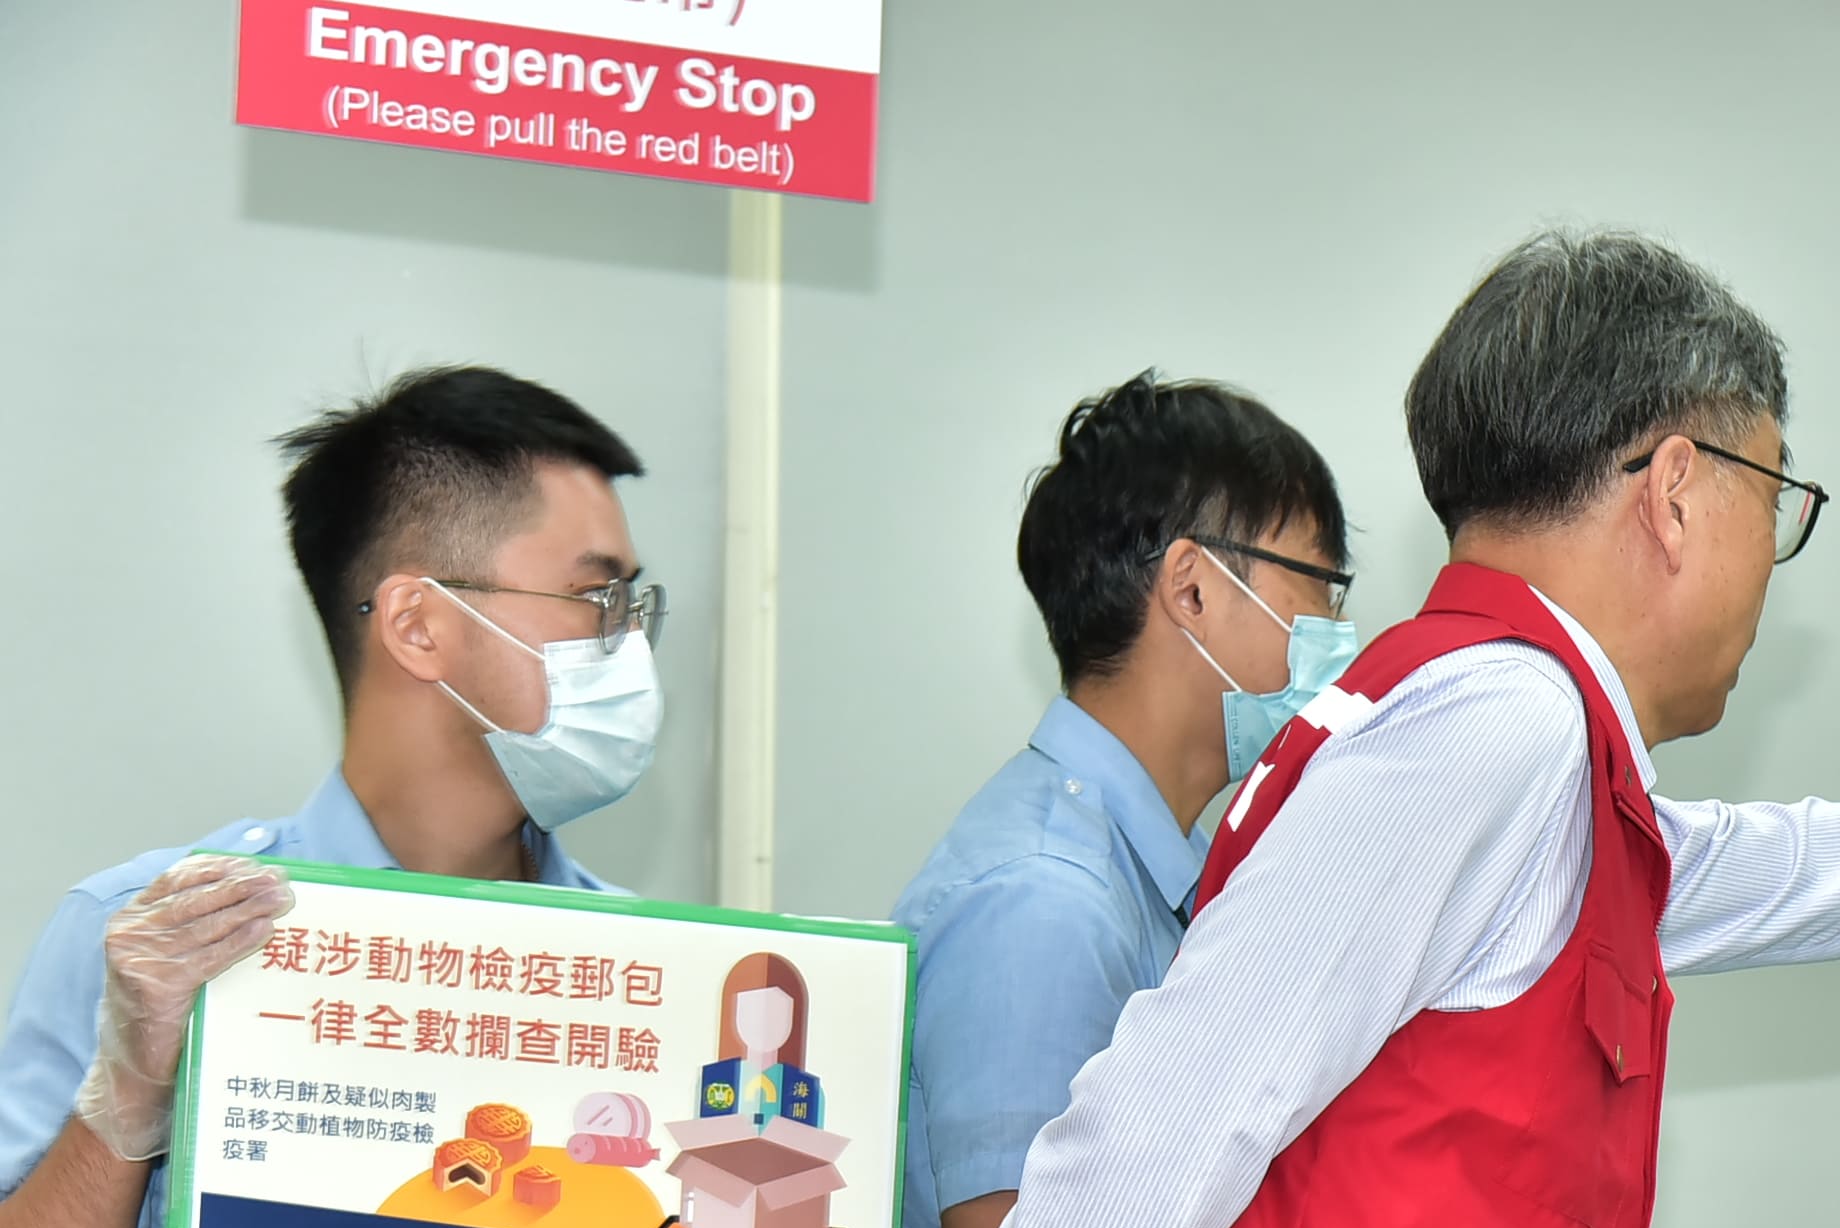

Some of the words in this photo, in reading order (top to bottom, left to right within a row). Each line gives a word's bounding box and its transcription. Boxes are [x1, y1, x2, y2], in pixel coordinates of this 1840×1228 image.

[307, 8, 657, 111] Emergency
[674, 58, 816, 129] Stop
[325, 84, 476, 137] (Please
[488, 112, 556, 148] pull
[568, 119, 627, 156] the
[639, 129, 700, 166] red
[712, 138, 796, 184] belt)
[261, 925, 665, 1008] 疑涉動物檢疫郵包
[258, 1003, 662, 1075] 一律全數攔查開驗
[224, 1106, 435, 1145] 品移交動植物防疫檢
[226, 1075, 438, 1114] 中秋月餅及疑似肉製
[222, 1138, 269, 1162] 疫署
